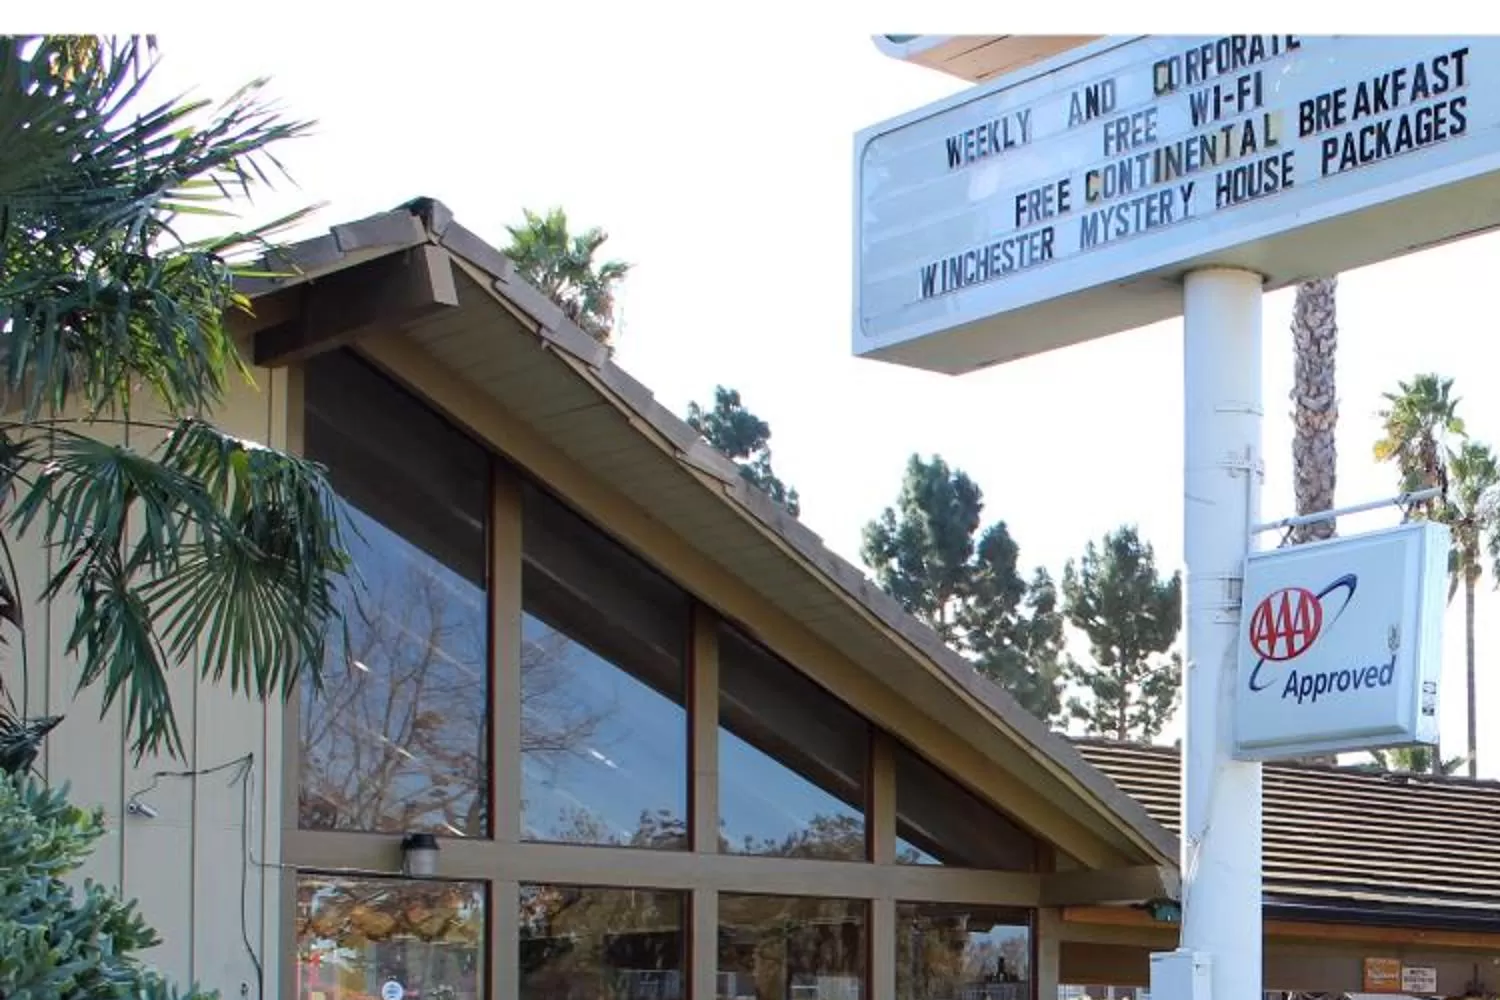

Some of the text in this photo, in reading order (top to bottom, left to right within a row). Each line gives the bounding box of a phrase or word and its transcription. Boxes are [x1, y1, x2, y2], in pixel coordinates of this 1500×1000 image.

[946, 108, 1031, 168] WEEKLY
[1068, 79, 1116, 128] AND
[1015, 47, 1469, 228] FREE CONTINENTAL BREAKFAST
[1103, 71, 1263, 157] FREE WI-FI
[920, 96, 1467, 299] WINCHESTER MYSTERY HOUSE PACKAGES
[1250, 587, 1322, 661] AAA
[1281, 654, 1396, 704] Approved
